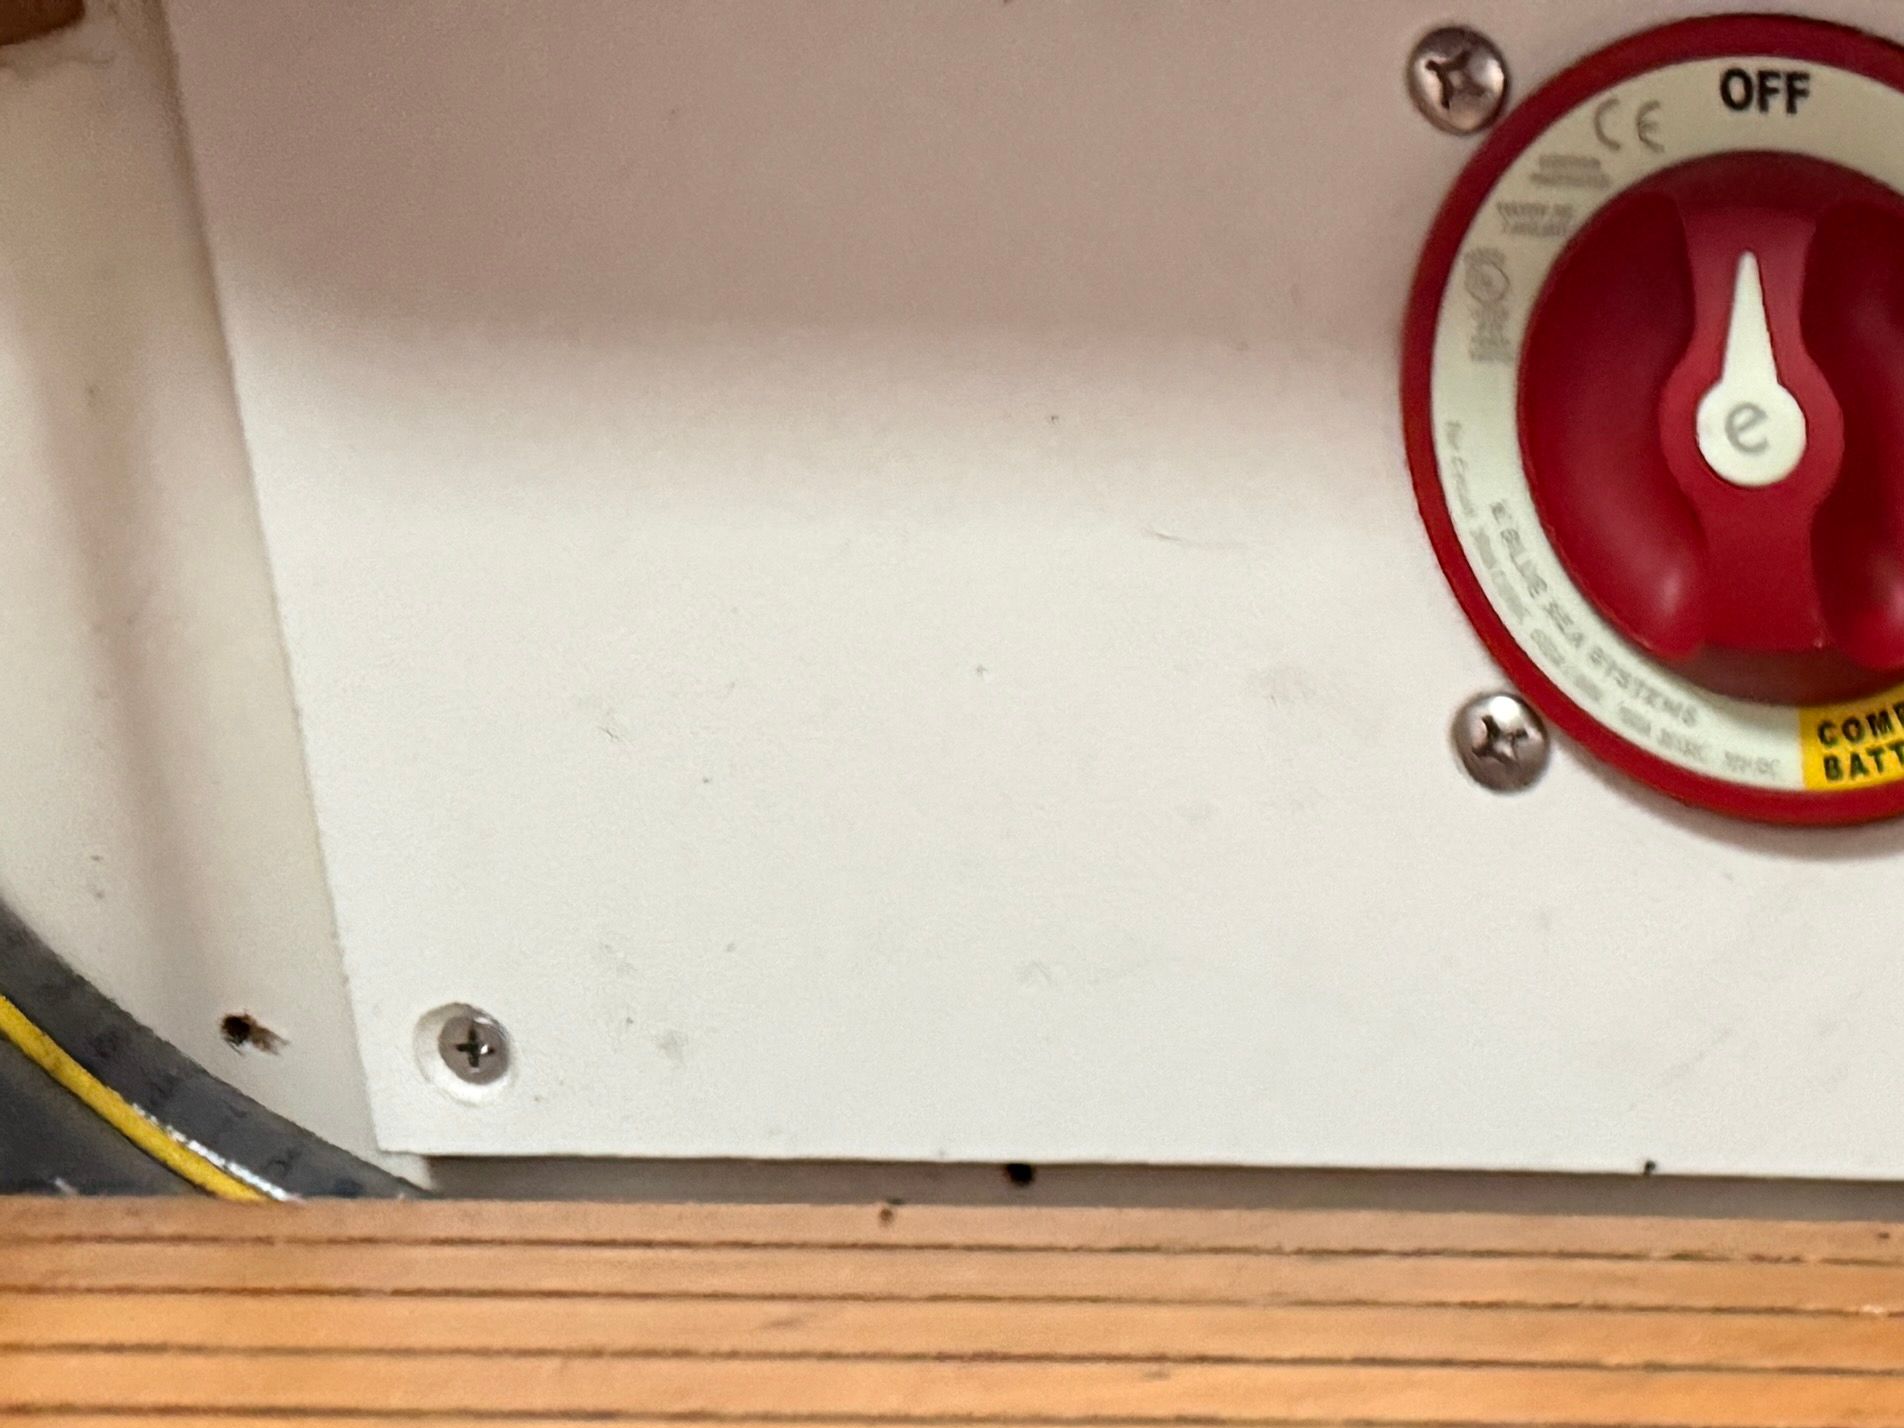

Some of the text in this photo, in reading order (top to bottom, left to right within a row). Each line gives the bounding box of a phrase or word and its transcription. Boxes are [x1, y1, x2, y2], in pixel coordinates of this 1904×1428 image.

[1719, 67, 1811, 114] OFF
[1593, 97, 1666, 152] CE
[1724, 402, 1770, 456] e
